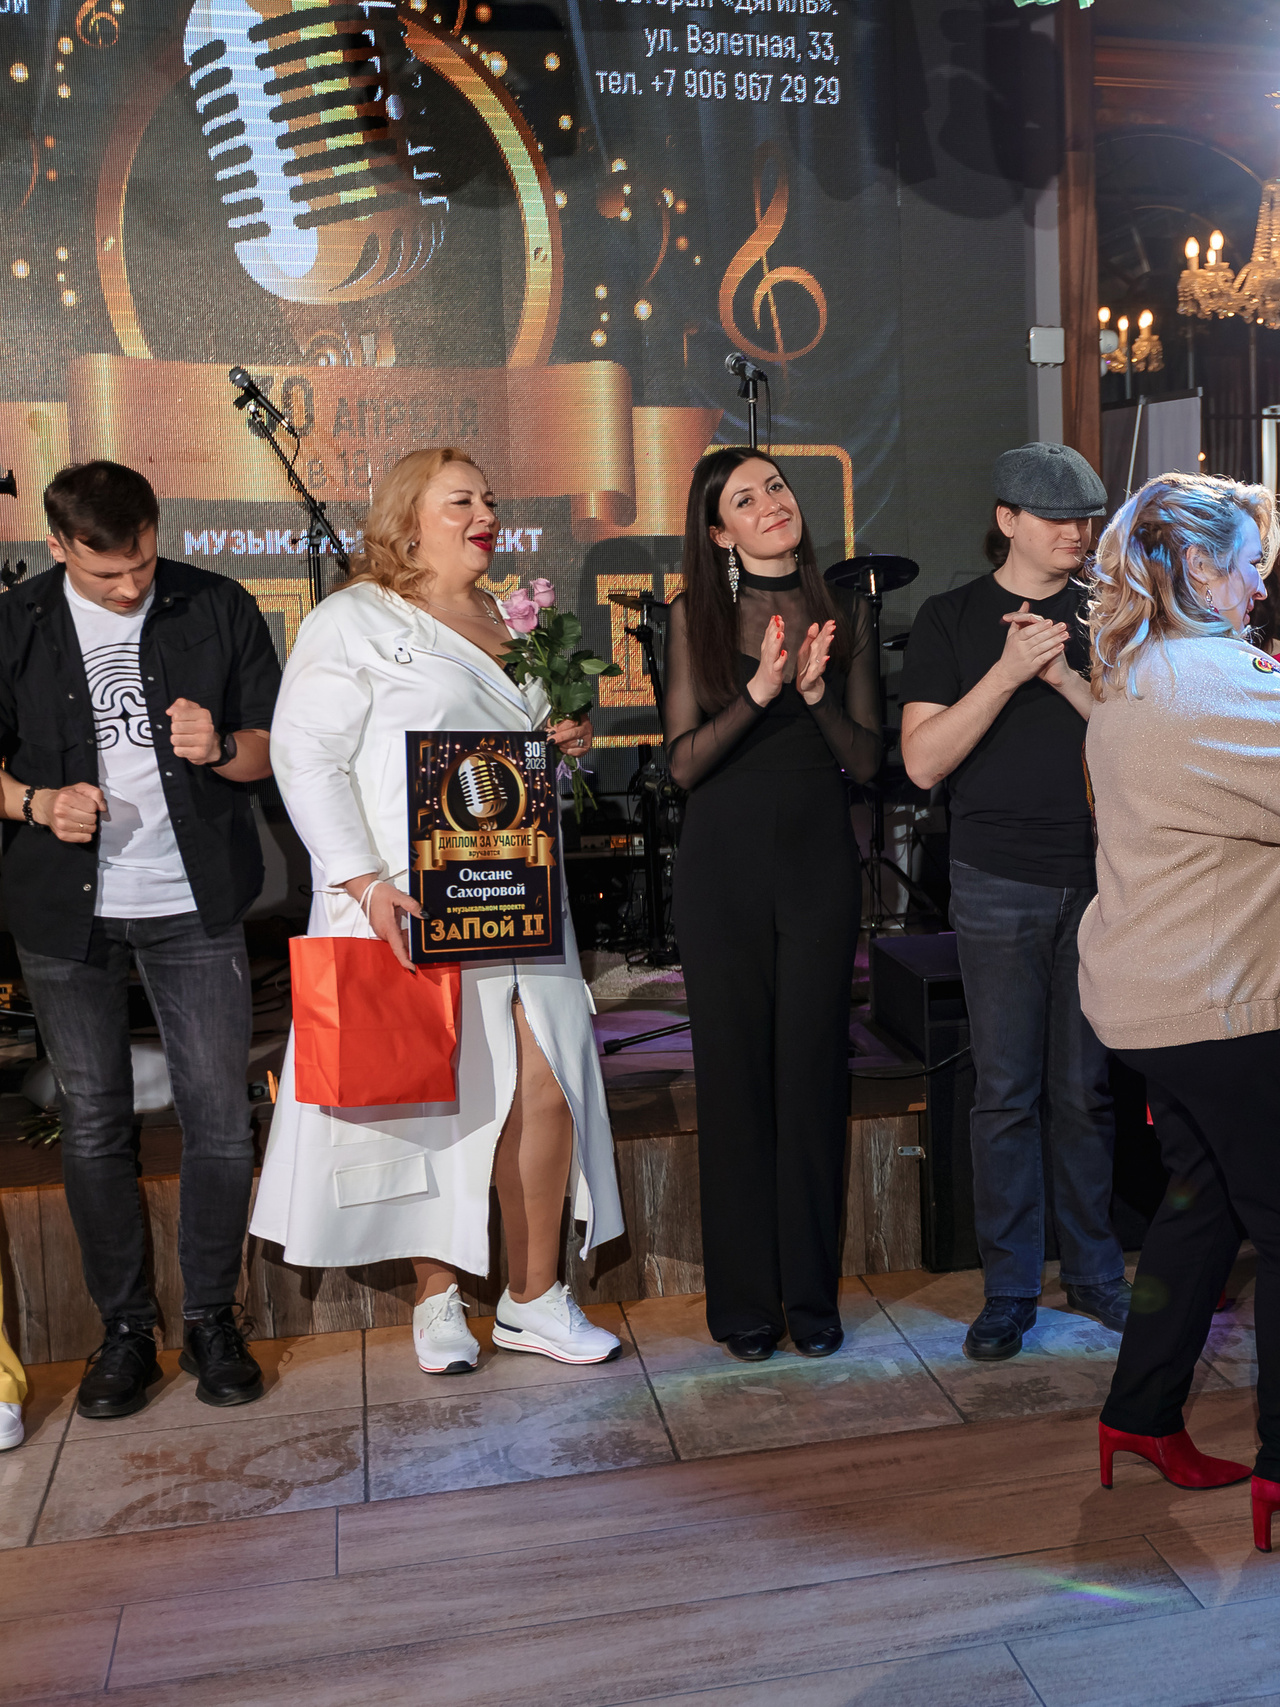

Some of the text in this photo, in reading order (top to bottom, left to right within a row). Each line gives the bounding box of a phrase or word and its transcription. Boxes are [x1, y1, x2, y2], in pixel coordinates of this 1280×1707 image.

[642, 23, 840, 65] ул. Взлетная, 33,
[595, 68, 840, 105] тел. +7 906 967 29 29
[524, 741, 541, 758] 30
[525, 757, 547, 770] 2023
[438, 834, 532, 850] ДИПЛОМ ЗА УЧАСТИЕ
[458, 868, 514, 882] Оксане
[446, 882, 526, 901] Сахоровой
